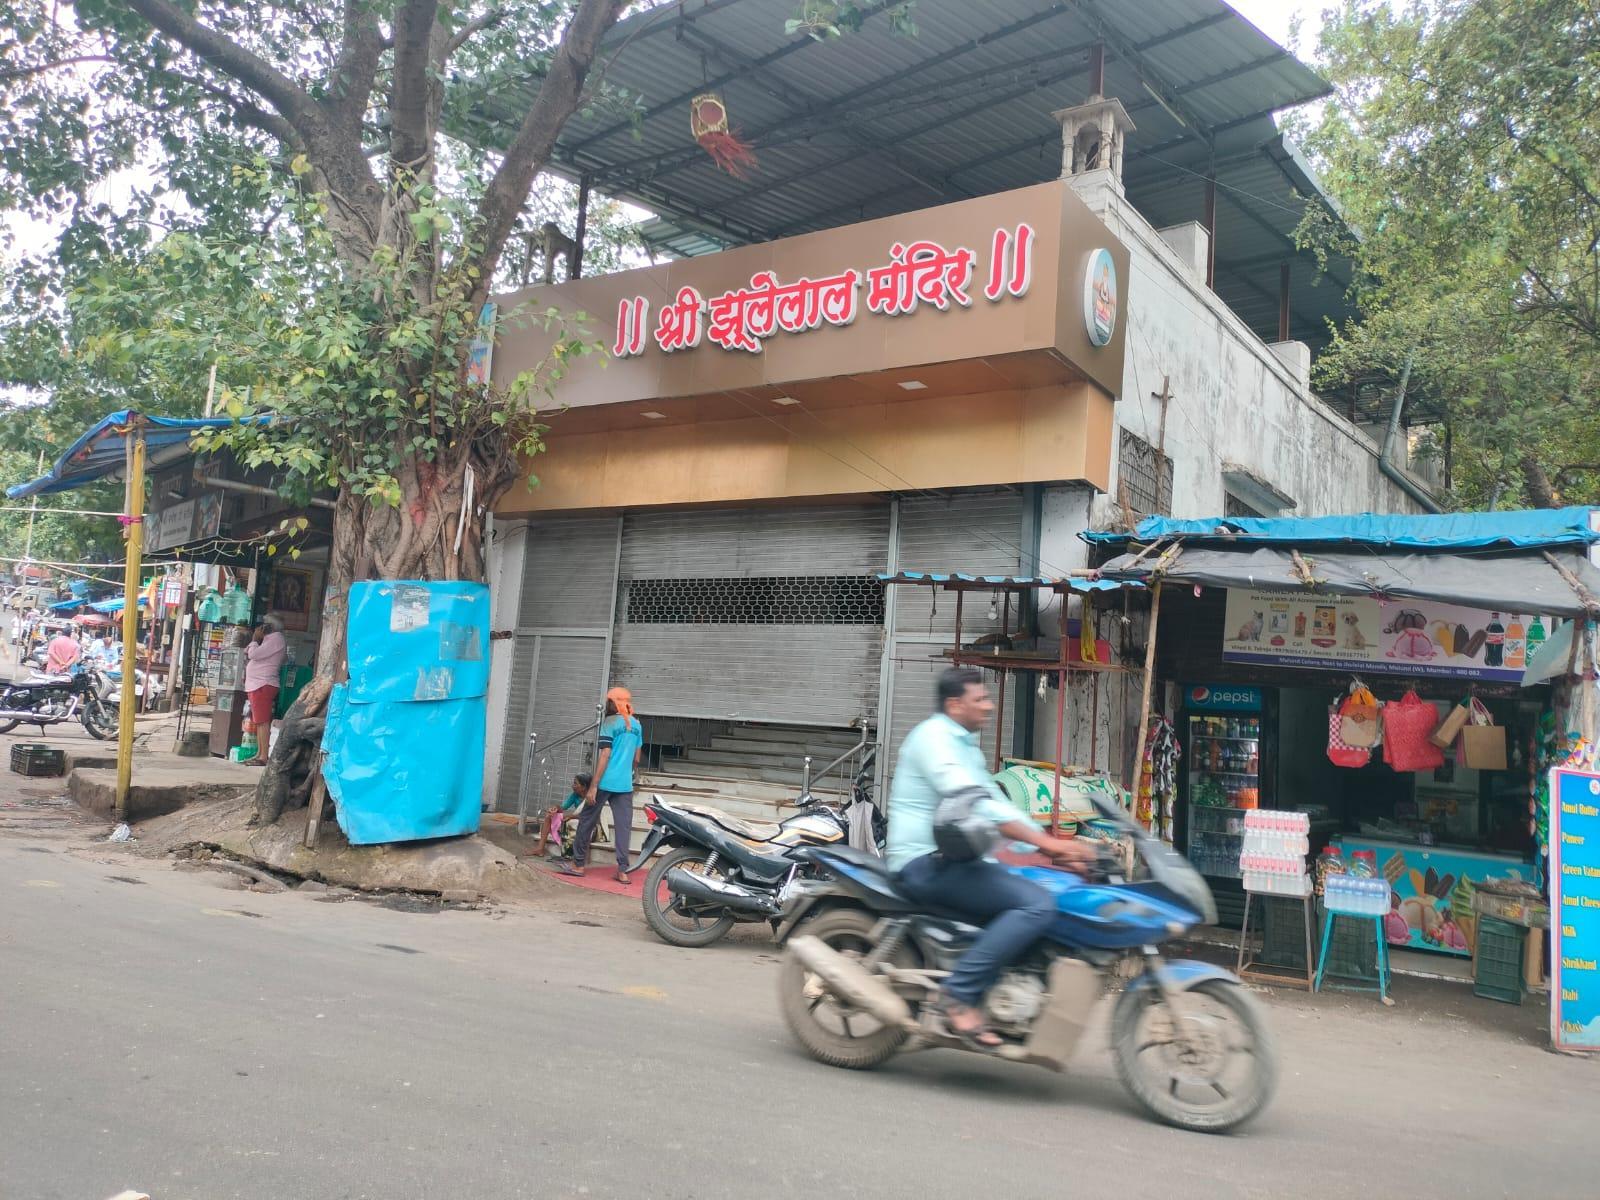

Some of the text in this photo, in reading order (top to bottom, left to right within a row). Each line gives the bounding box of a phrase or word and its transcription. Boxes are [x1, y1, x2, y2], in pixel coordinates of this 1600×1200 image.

[654, 286, 706, 352] श्री
[708, 270, 861, 353] झूलेलाल
[867, 240, 976, 315] मंदिर
[1426, 666, 1452, 674] Mumbai
[1213, 691, 1253, 704] pepsi
[1562, 801, 1599, 816] Amul Butter
[1562, 831, 1585, 845] Paneer
[1562, 863, 1582, 876] Green
[1562, 894, 1579, 907] Amul
[1562, 924, 1577, 938] Milk
[1562, 988, 1579, 1001] Dahi
